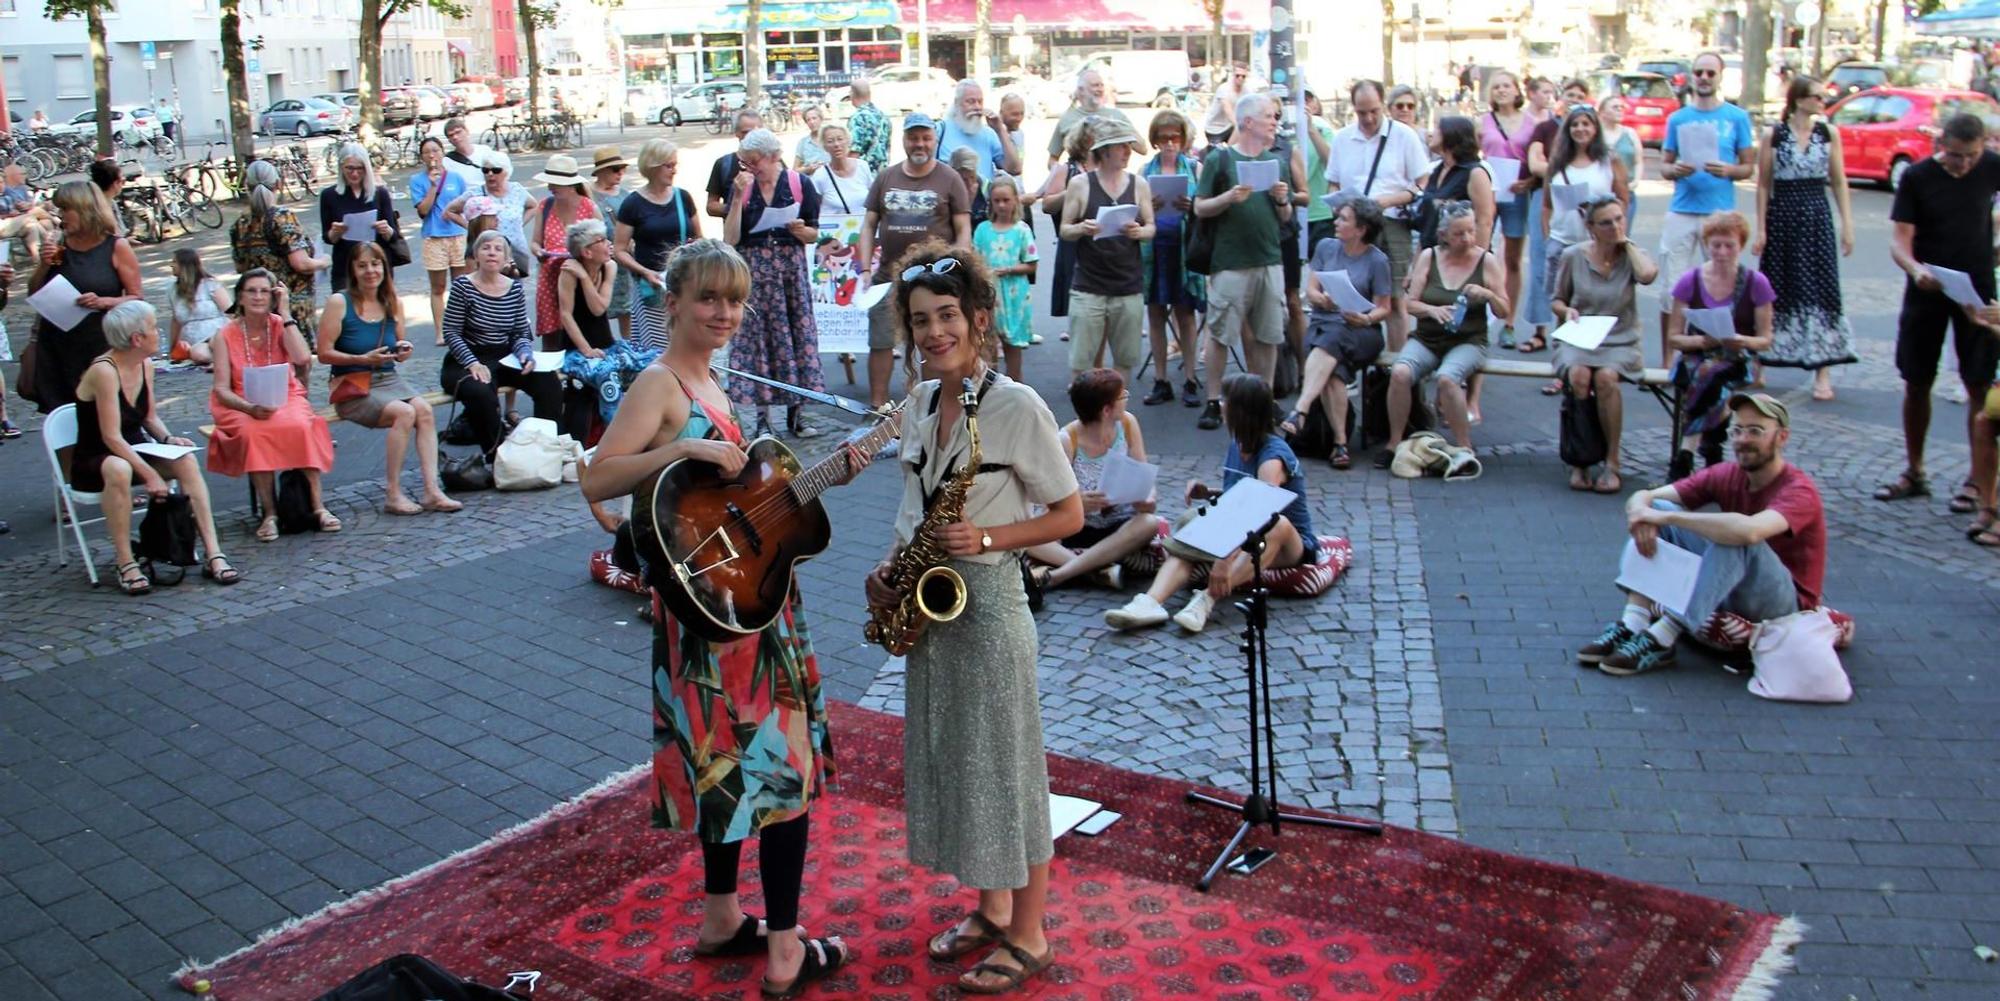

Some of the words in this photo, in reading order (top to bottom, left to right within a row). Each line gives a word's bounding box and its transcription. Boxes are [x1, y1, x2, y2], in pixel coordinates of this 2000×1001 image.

[815, 309, 869, 320] ieblingslie
[817, 320, 842, 329] ngen
[843, 319, 861, 327] mit
